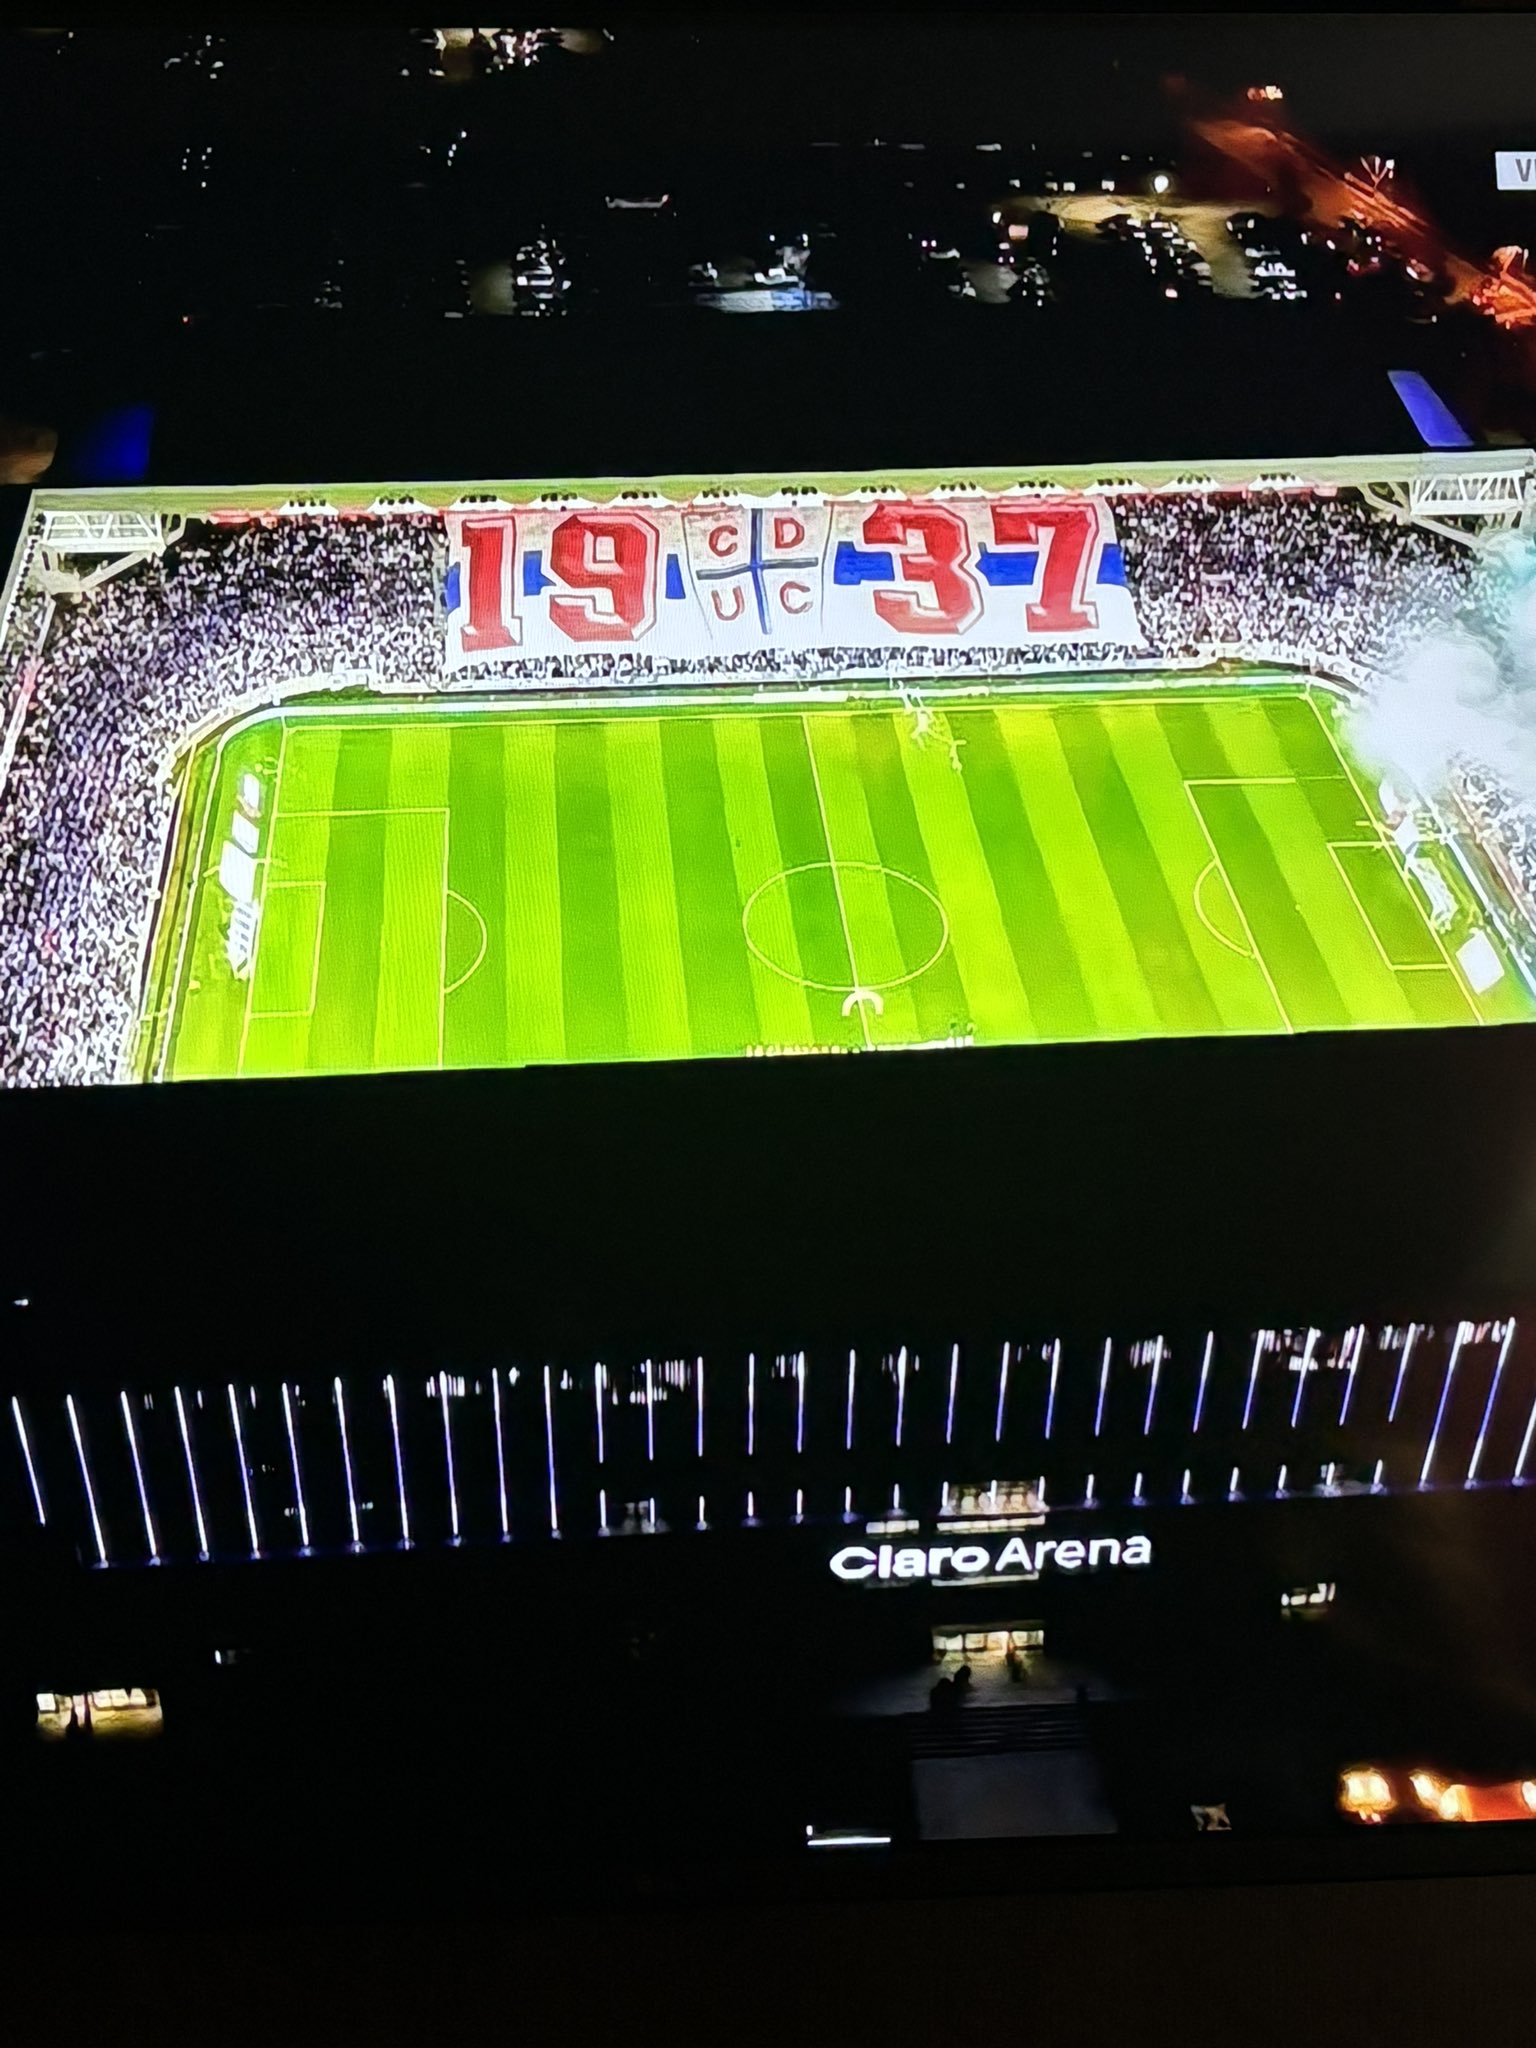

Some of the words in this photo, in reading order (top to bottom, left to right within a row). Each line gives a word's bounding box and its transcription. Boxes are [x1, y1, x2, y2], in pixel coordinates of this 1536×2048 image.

[1514, 158, 1536, 182] V
[829, 1544, 991, 1580] Claro
[994, 1534, 1153, 1573] Arena
